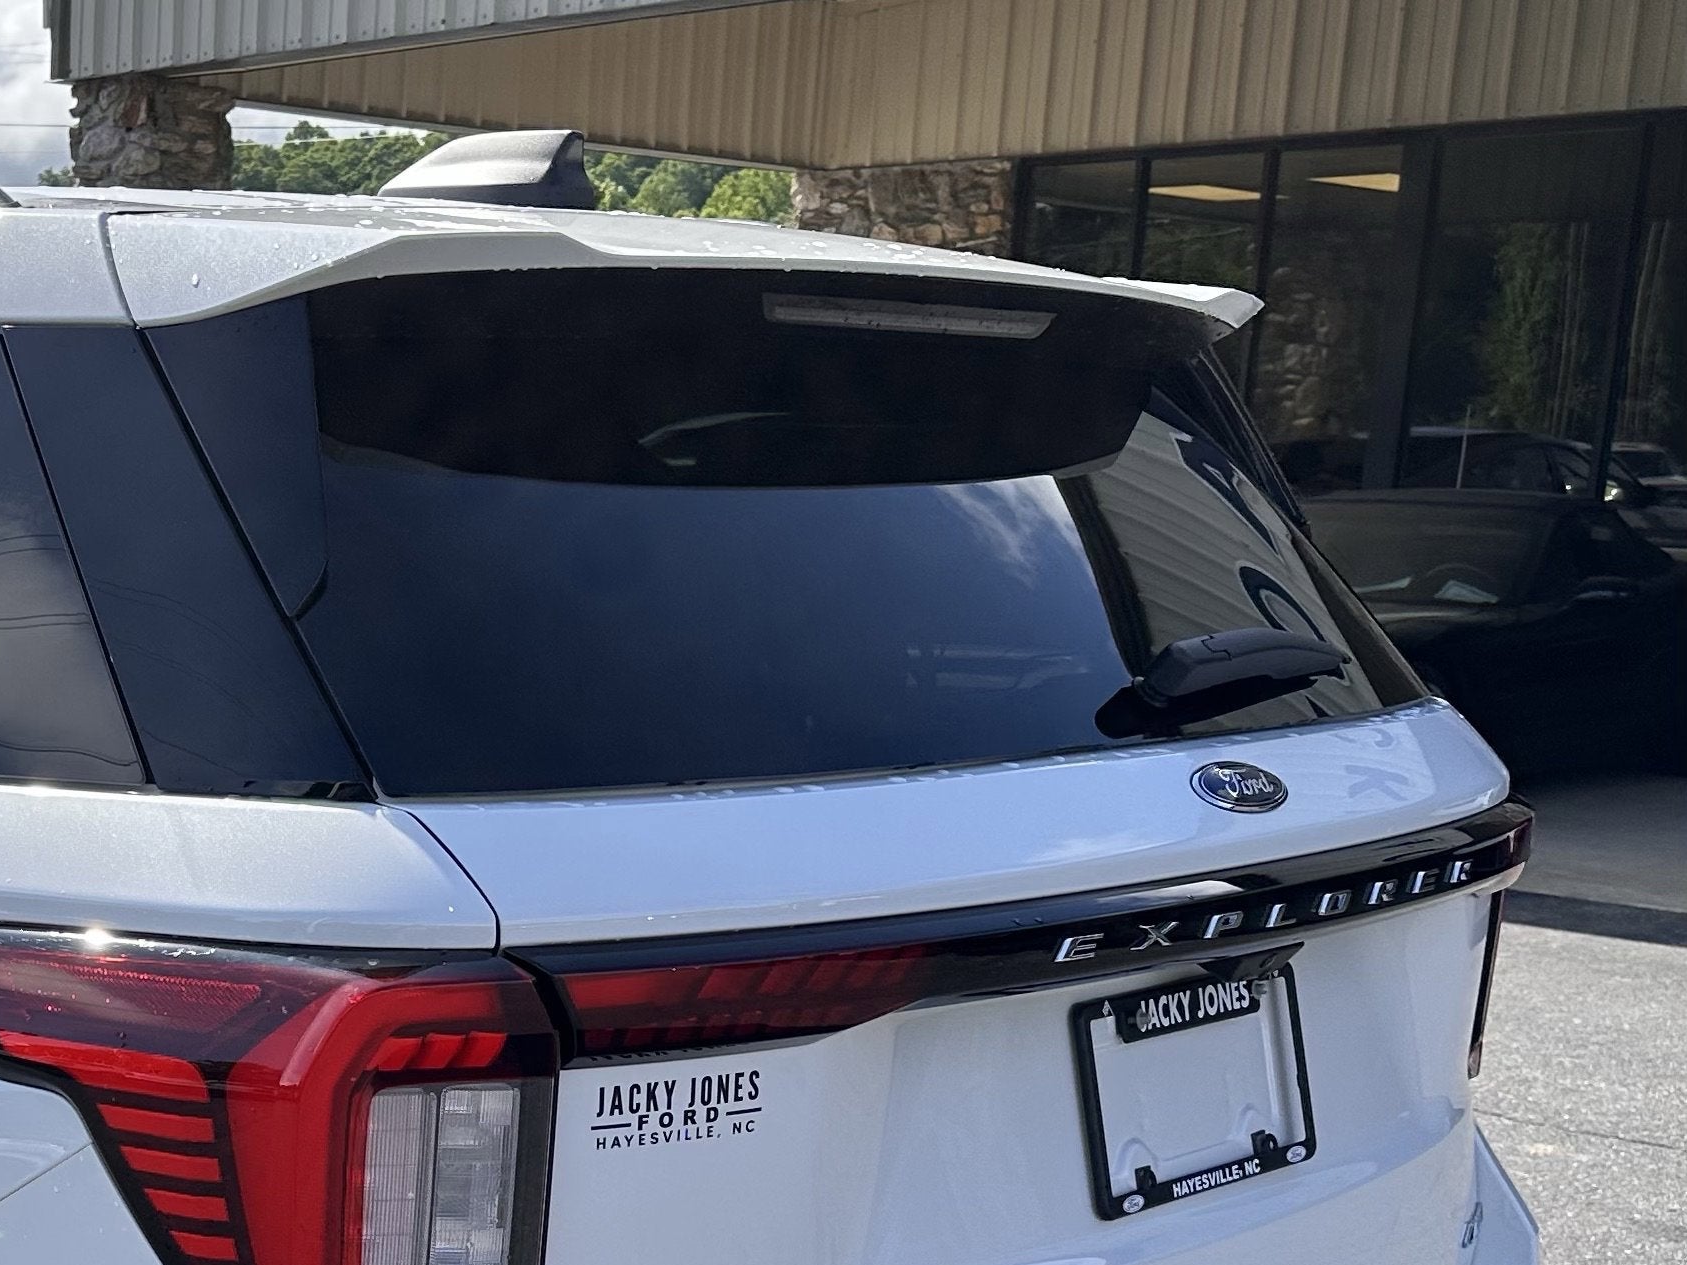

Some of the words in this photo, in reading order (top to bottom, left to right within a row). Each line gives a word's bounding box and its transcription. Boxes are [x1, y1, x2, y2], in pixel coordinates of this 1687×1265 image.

[1214, 766, 1275, 798] Ford
[1052, 857, 1475, 964] EXPLORER
[1138, 988, 1192, 1033] JACKY
[1196, 979, 1251, 1020] JONES
[595, 1079, 678, 1119] JACKY
[687, 1069, 761, 1109] JONES
[595, 1124, 723, 1151] HAYESVILLE,
[731, 1119, 757, 1136] NC
[637, 1106, 720, 1132] FORD
[1171, 1163, 1244, 1199] HAYESVILLE,
[1244, 1157, 1262, 1177] NC
